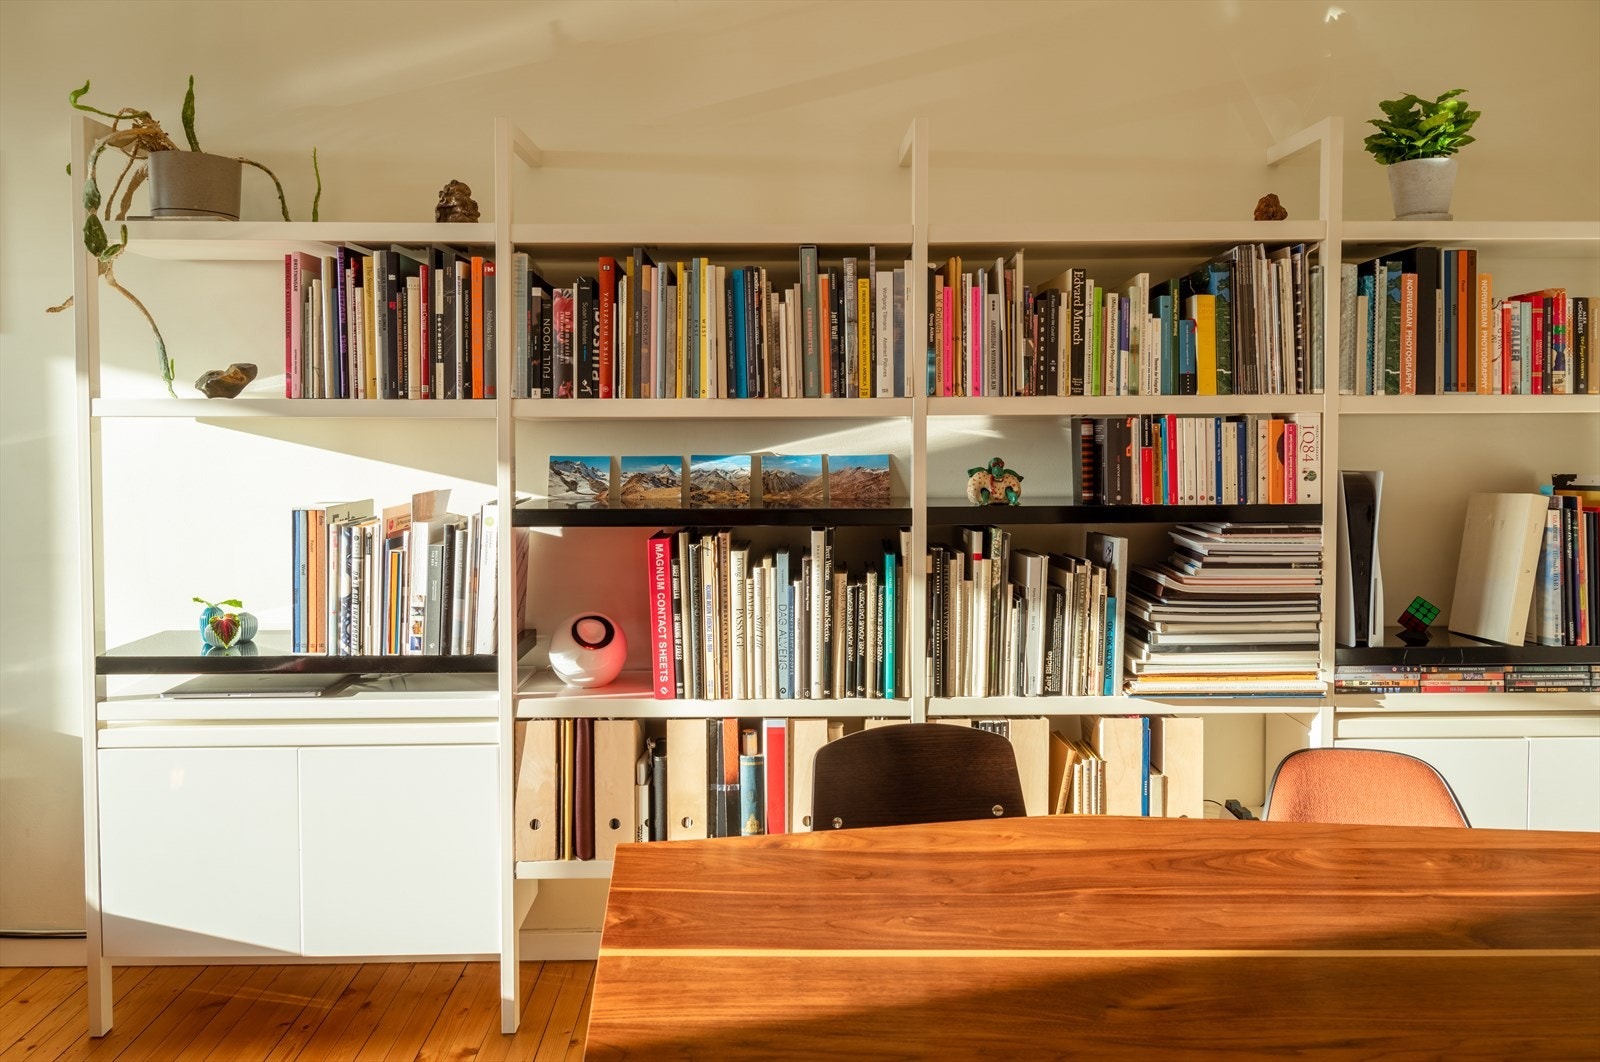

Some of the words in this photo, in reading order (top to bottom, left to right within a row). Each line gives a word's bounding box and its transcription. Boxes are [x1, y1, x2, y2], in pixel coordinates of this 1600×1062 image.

[846, 262, 854, 282] THOMAS
[846, 282, 854, 300] STRUTH
[1073, 270, 1084, 307] Edvard
[486, 310, 494, 334] Nicholas
[582, 302, 590, 319] Susan
[935, 306, 943, 334] Dolven
[542, 318, 551, 352] MOON
[582, 320, 590, 345] Meiselas
[1073, 308, 1084, 346] Munch
[486, 334, 494, 350] Nixon
[1511, 325, 1520, 362] FALLER
[542, 356, 551, 380] FULL
[1109, 350, 1117, 383] Photography
[1299, 424, 1316, 463] 1Q84
[824, 545, 832, 560] Brett
[655, 543, 665, 590] MAGNUM
[722, 574, 728, 582] IN
[734, 556, 744, 578] Irving
[824, 560, 832, 581] Weston
[736, 579, 744, 596] Penn
[657, 592, 667, 639] CONTACT
[778, 604, 788, 626] DAG
[824, 596, 832, 617] Personal
[674, 620, 682, 638] MAKING
[736, 608, 744, 651] PASSAGE
[824, 618, 832, 642] Selection
[660, 641, 668, 682] SHEETS
[778, 629, 788, 670] ALVENG
[1045, 650, 1053, 674] Blicke
[1106, 649, 1114, 680] MINOLTA
[1045, 674, 1053, 692] Zeit
